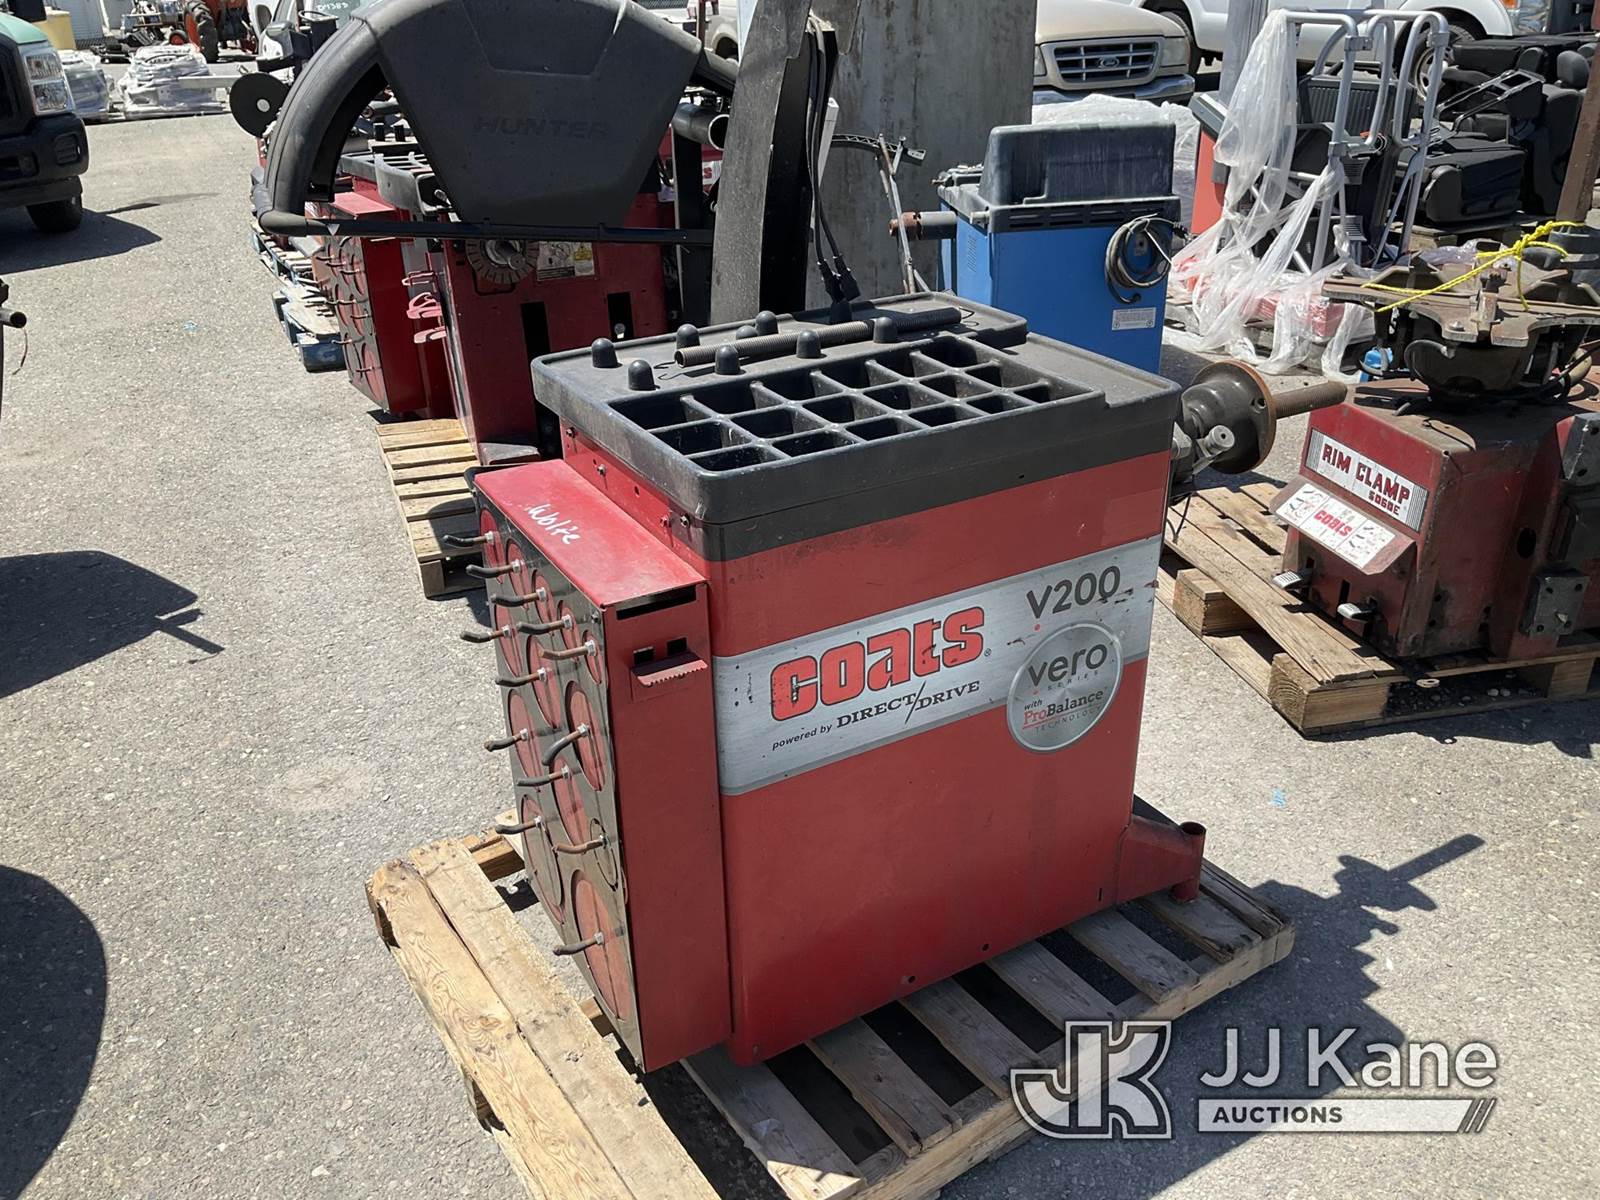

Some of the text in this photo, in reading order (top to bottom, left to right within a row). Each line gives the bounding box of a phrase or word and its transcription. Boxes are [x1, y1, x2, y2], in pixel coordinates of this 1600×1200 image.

[472, 117, 609, 140] HUNTER
[1322, 443, 1411, 504] RIM CLAMP
[1026, 565, 1121, 619] V200
[1028, 644, 1108, 687] vero
[1047, 670, 1099, 692] SERIES
[1023, 690, 1104, 726] ProBalance
[1024, 699, 1043, 712] with
[1035, 705, 1101, 733] TECHNOLOGY
[772, 728, 817, 751] powered
[820, 724, 833, 735] by
